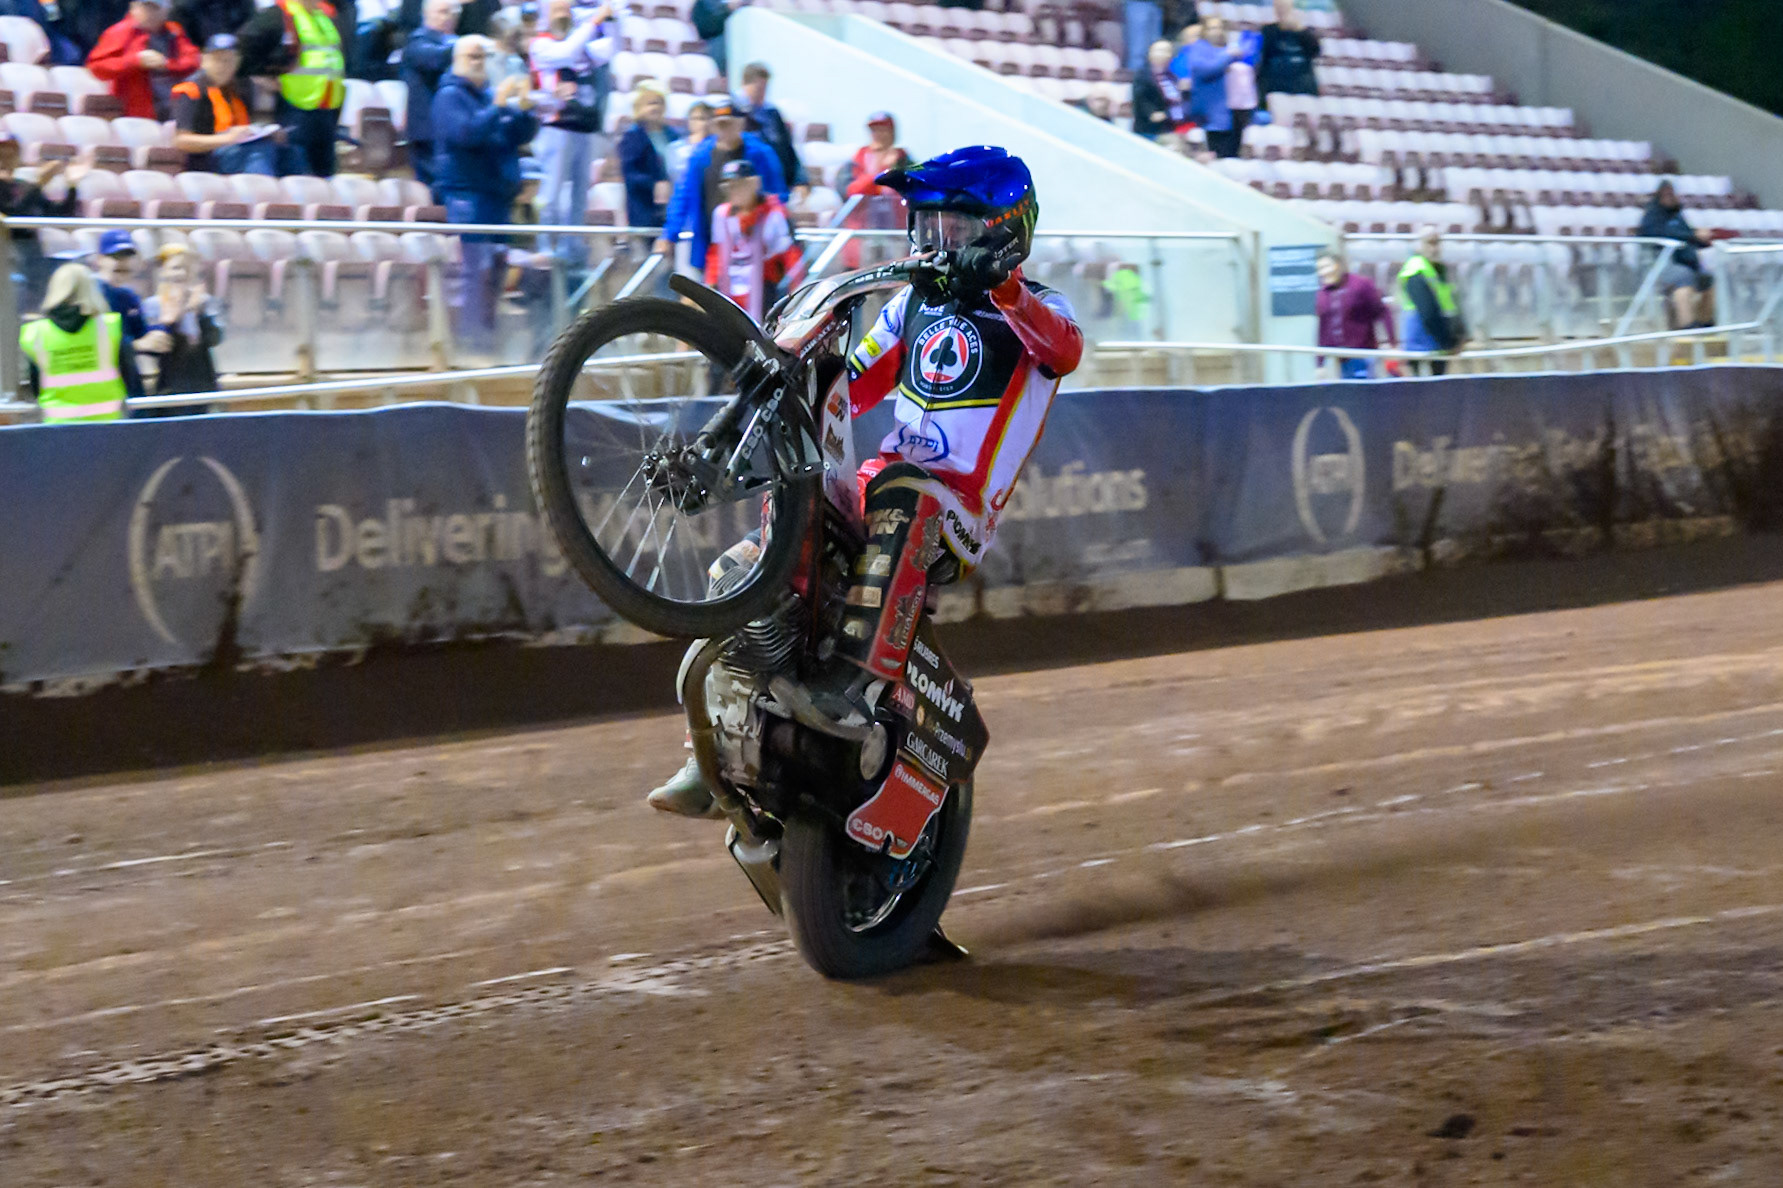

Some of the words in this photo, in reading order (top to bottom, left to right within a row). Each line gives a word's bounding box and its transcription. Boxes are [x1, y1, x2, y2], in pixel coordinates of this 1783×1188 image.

[918, 322, 945, 346] BELLE
[966, 330, 979, 354] ACES
[761, 387, 784, 422] CSO
[741, 424, 764, 460] CSO
[1007, 460, 1148, 521] olutions
[852, 817, 883, 841] CSO
